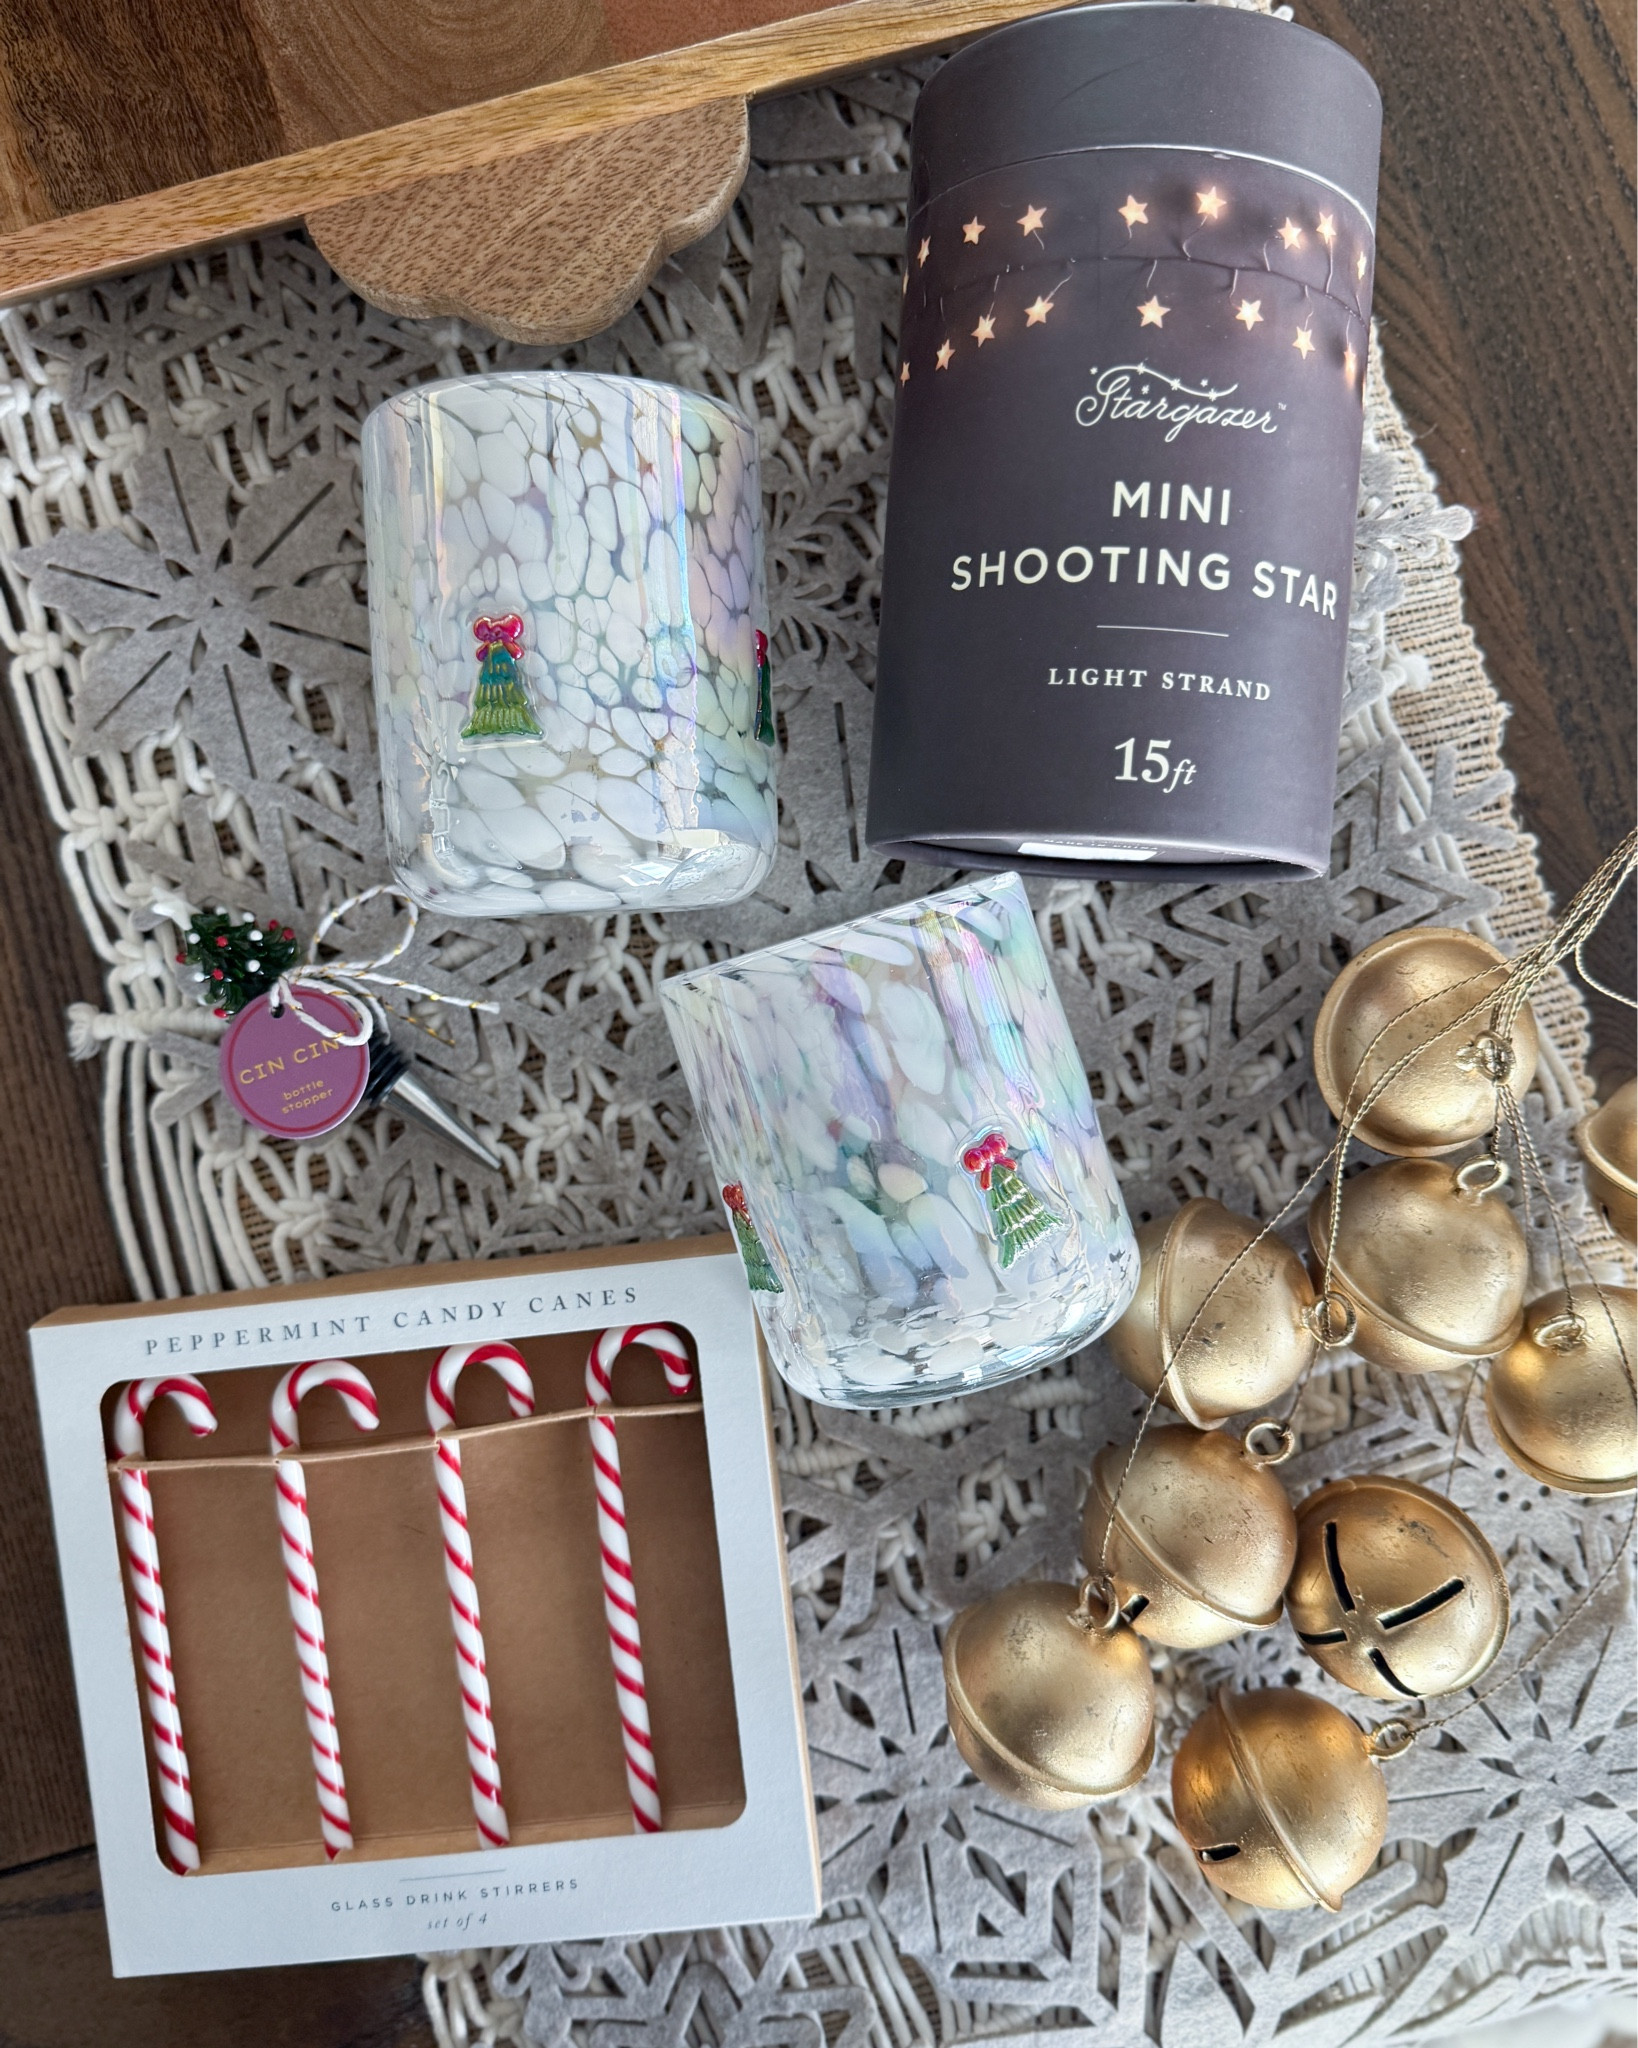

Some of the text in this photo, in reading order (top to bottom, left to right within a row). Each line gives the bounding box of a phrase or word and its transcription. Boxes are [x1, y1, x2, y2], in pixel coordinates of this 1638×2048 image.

[1076, 364, 1279, 443] Stargazer
[1111, 480, 1232, 526] MINI
[950, 545, 1338, 621] SHOOTING STAR
[1047, 667, 1272, 702] LIGHT STRAND
[239, 1038, 340, 1085] CIN CIN
[281, 1088, 334, 1115] stopper
[283, 1079, 325, 1101] bottle
[145, 1286, 638, 1357] PEPPERMINT CANDY CANES
[331, 1878, 579, 1912] GLASS DRINK STIRRERS
[427, 1912, 489, 1932] set of 4
